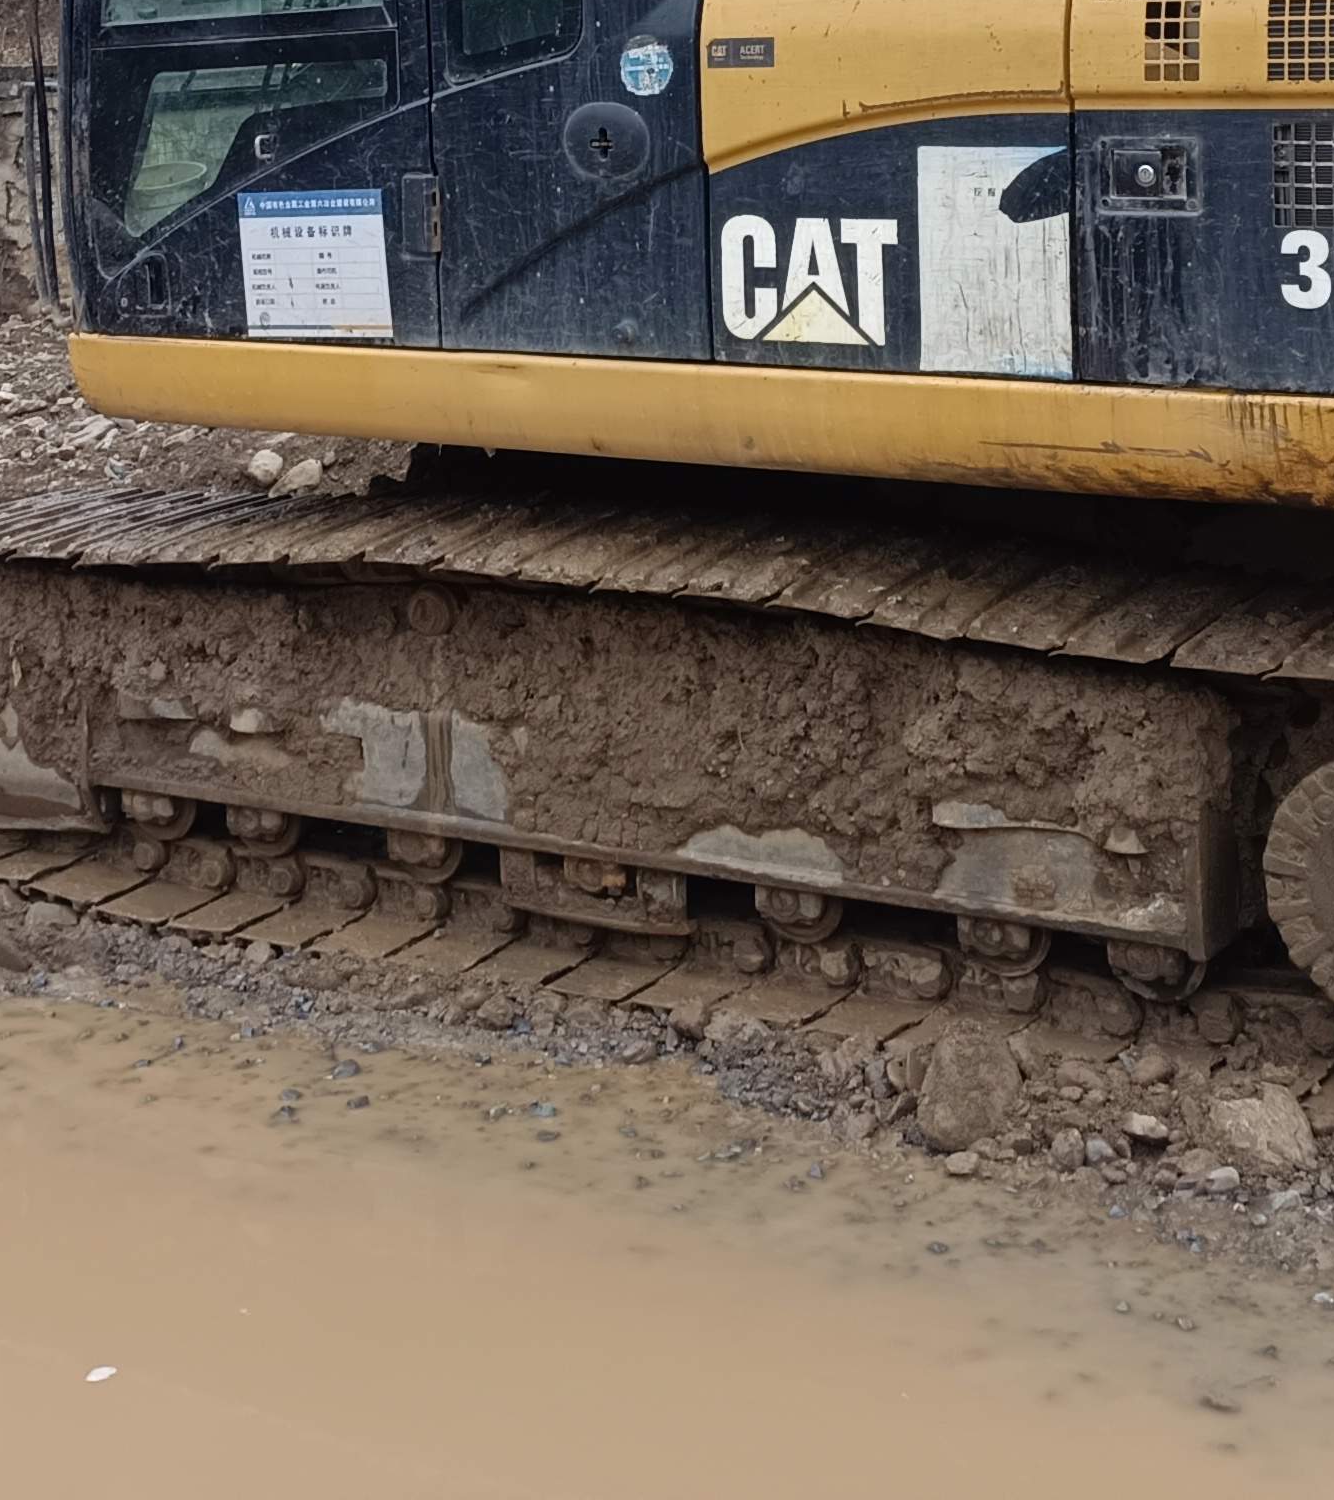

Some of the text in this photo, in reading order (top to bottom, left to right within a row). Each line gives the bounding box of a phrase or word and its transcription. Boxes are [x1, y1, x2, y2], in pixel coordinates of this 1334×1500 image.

[711, 44, 728, 57] CAT
[270, 225, 352, 239] 机械设备标识牌
[720, 214, 898, 347] CAT
